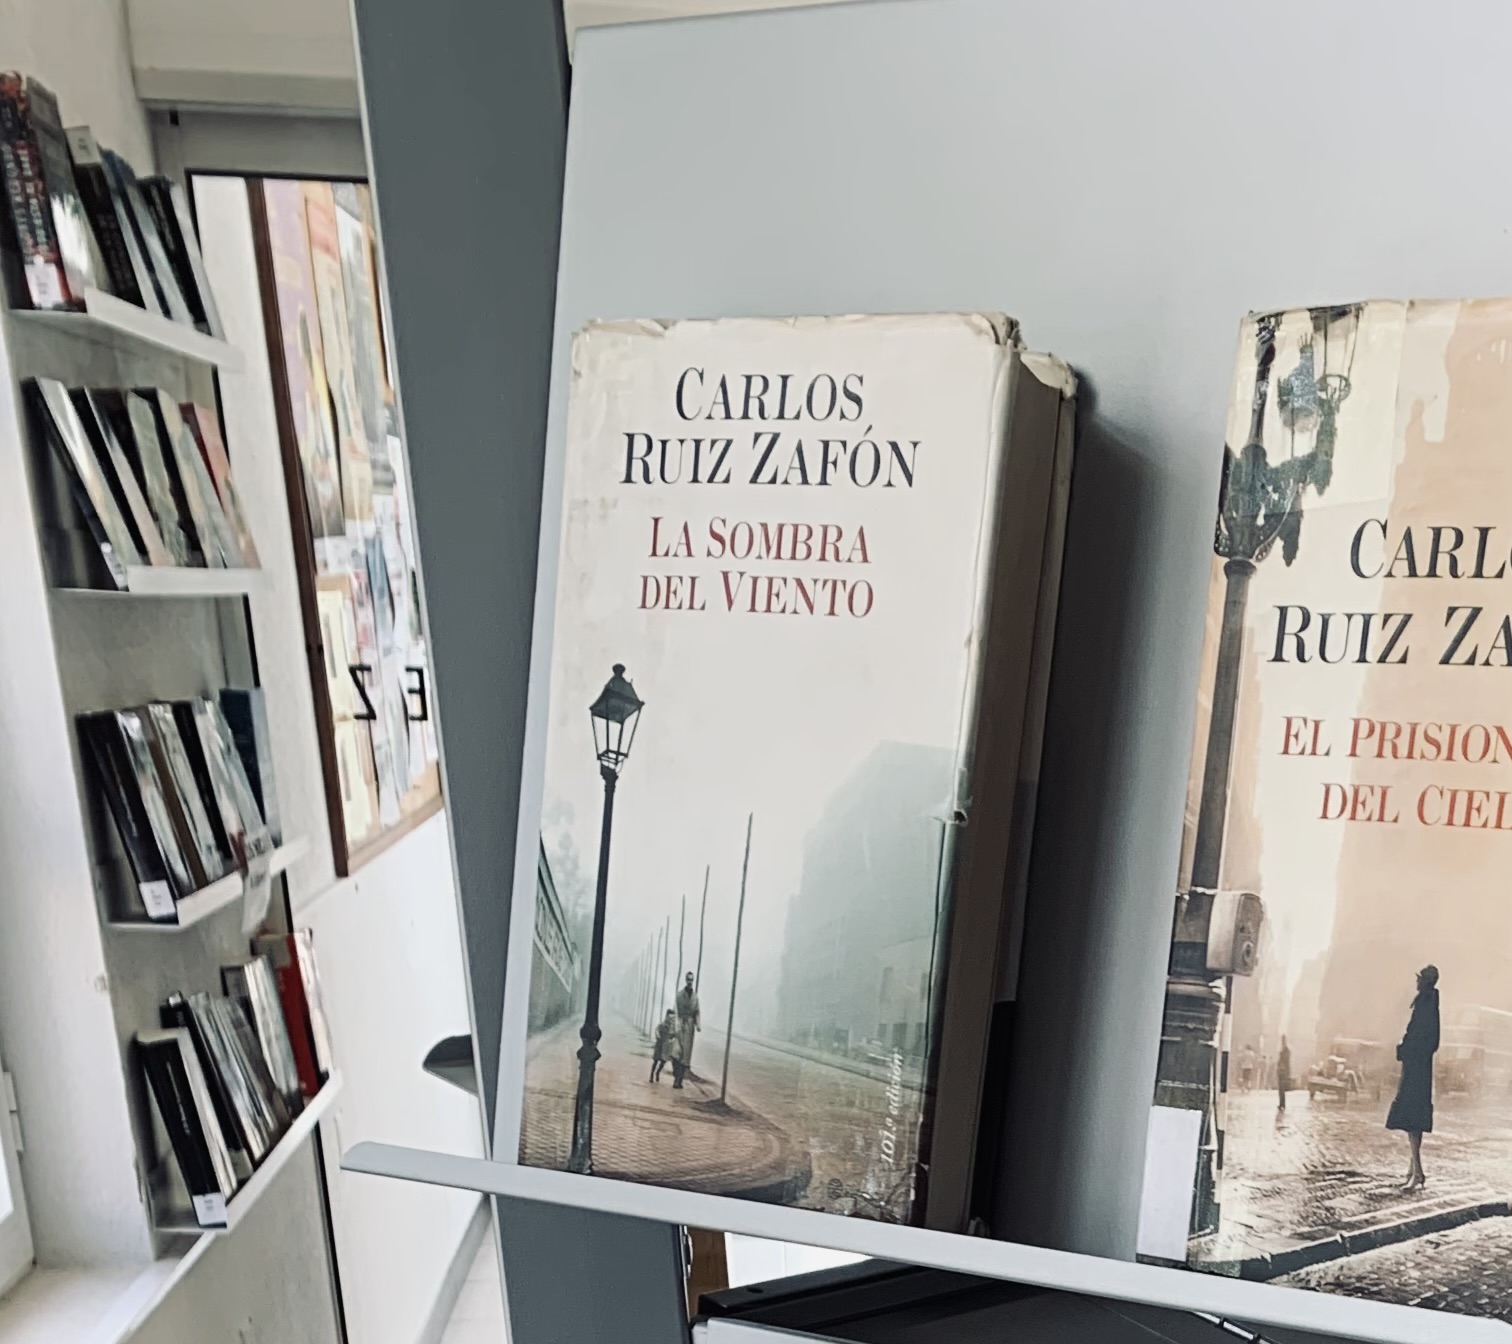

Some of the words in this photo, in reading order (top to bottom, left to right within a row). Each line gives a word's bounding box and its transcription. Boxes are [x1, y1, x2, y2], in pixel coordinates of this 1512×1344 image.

[676, 367, 866, 424] CARLOS
[620, 431, 734, 487] RUIZ
[750, 425, 922, 489] ZAFÓN
[648, 516, 696, 560] LA
[706, 516, 872, 566] SOMBRA
[638, 574, 707, 613] DEL
[719, 571, 875, 620] VIENTO
[1266, 604, 1412, 668] RUIZ
[1280, 716, 1332, 759] EL
[1318, 783, 1401, 826] DEL
